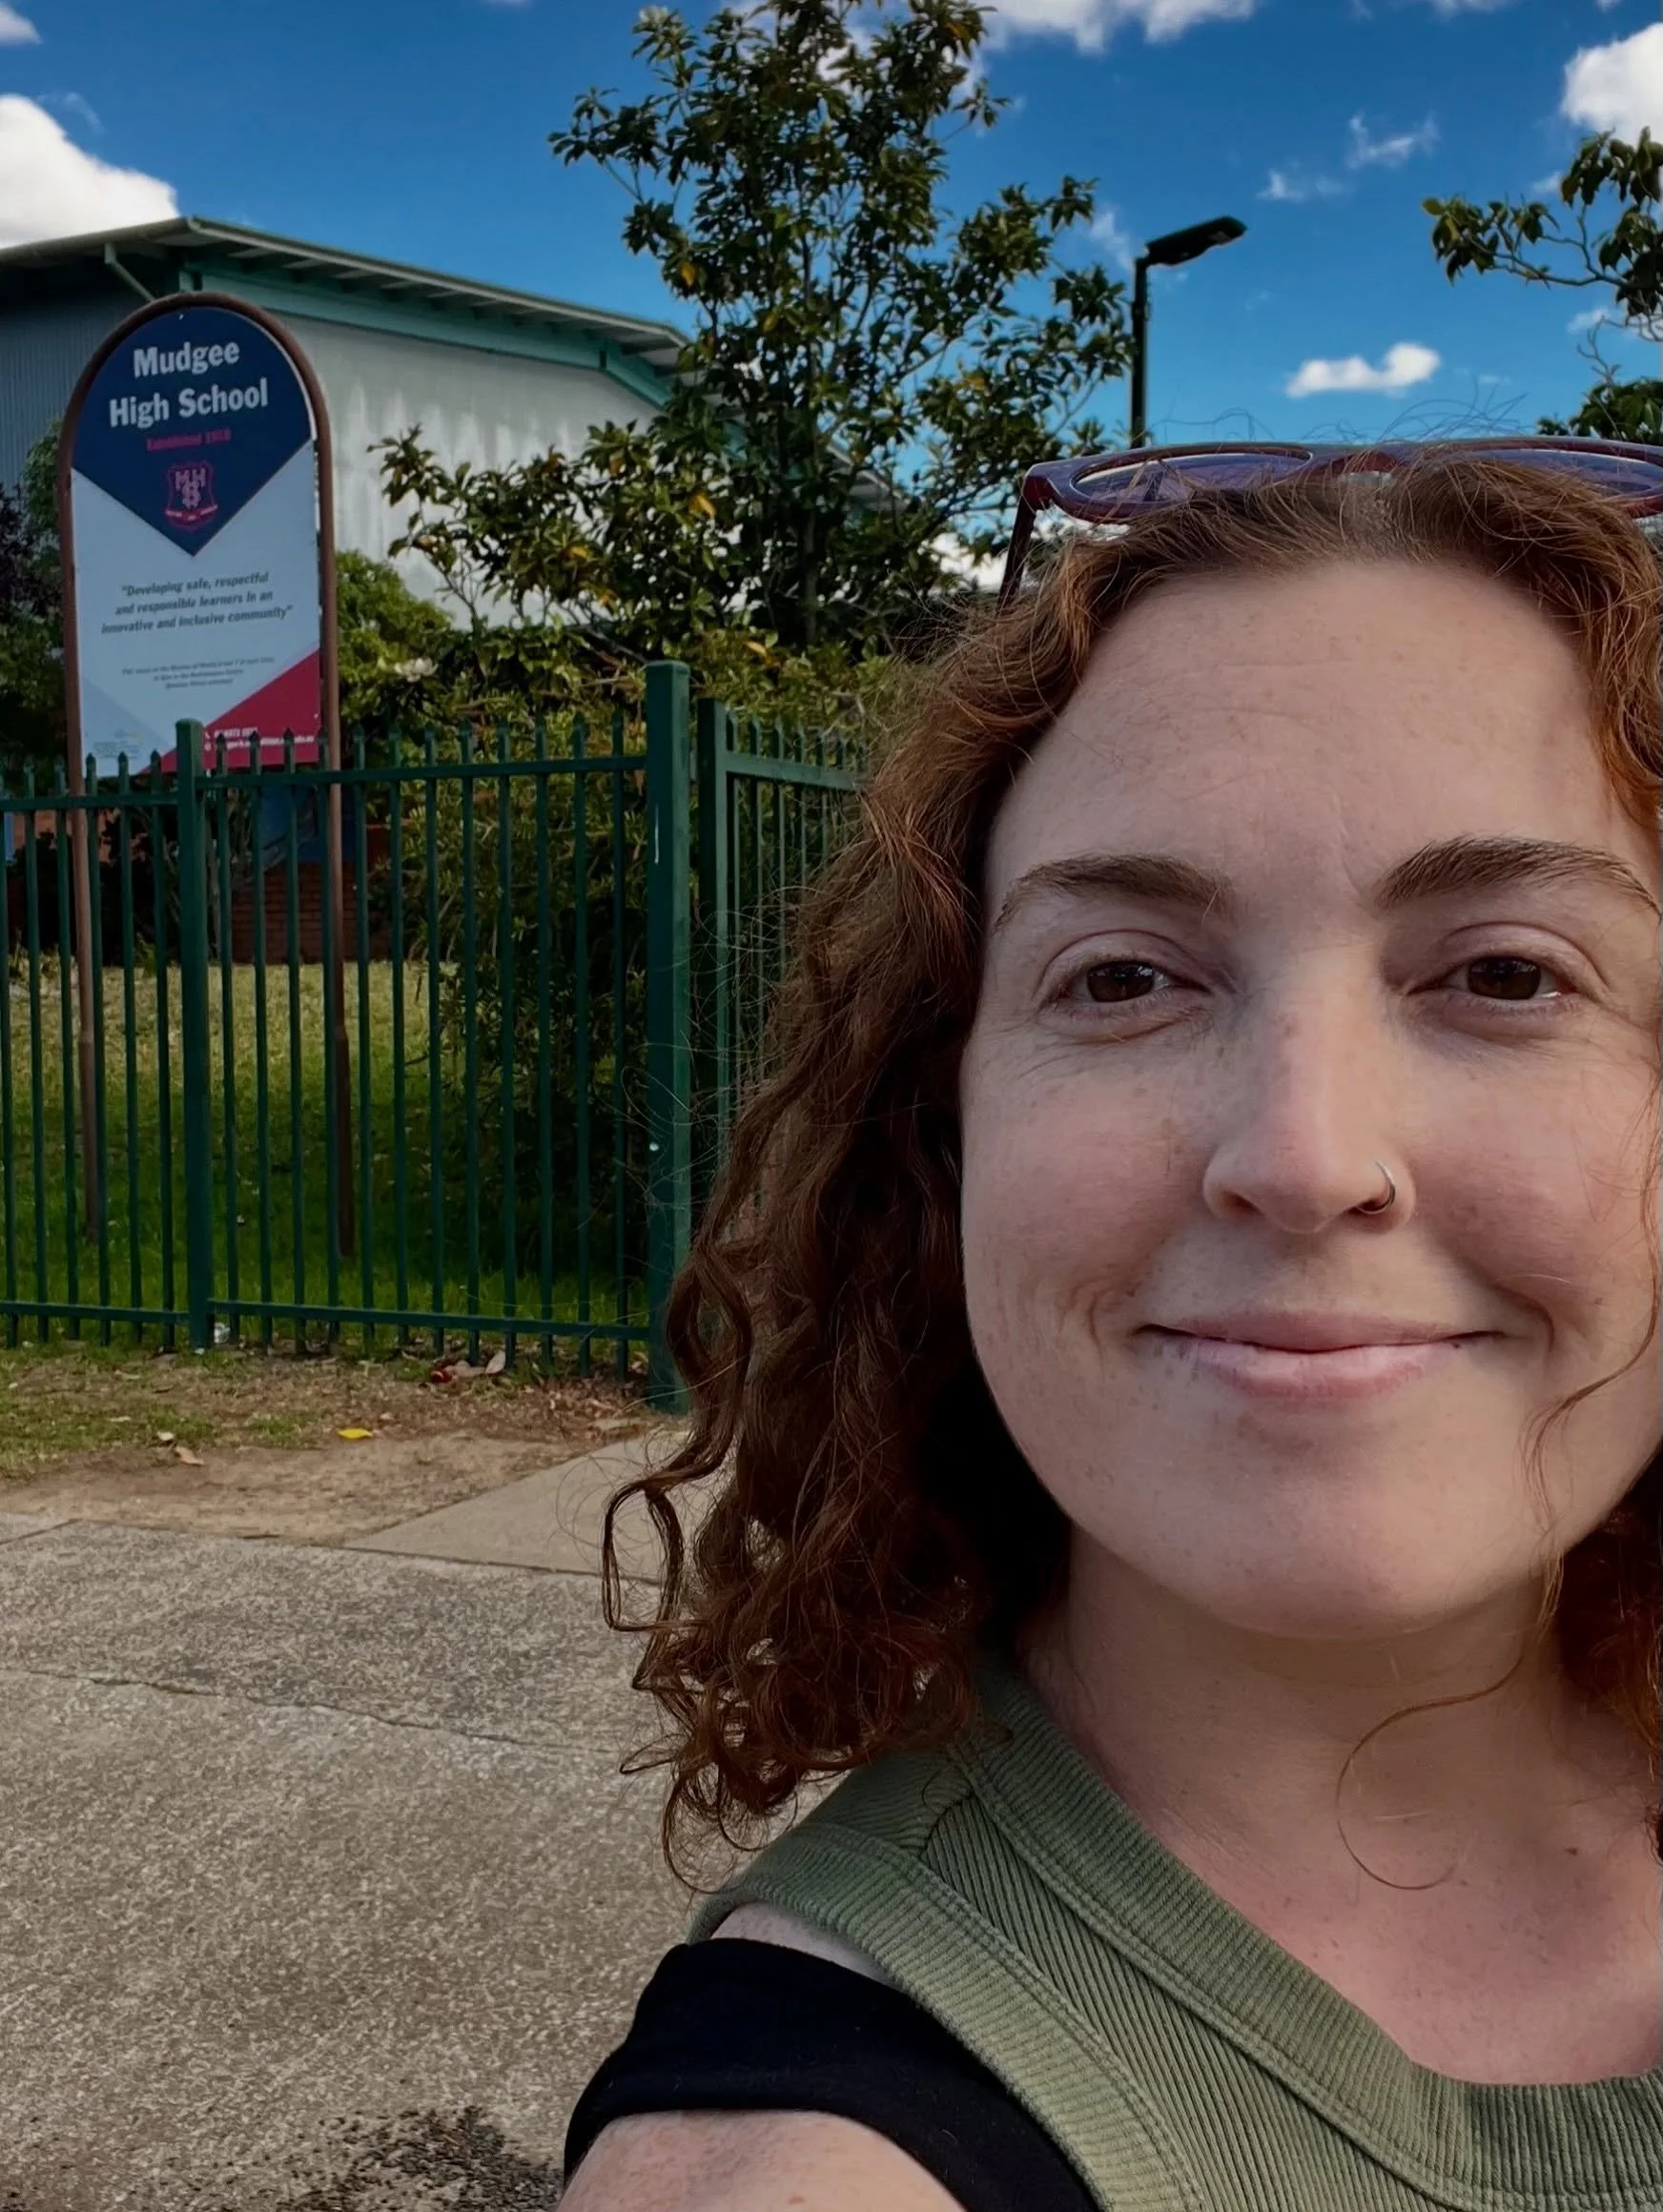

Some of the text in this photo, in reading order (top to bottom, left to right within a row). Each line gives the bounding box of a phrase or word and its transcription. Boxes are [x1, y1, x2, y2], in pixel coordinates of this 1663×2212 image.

[133, 341, 240, 379] Mudgee
[109, 377, 269, 428] High School
[186, 578, 212, 591] safe,
[215, 571, 270, 589] respectful
[114, 590, 274, 615] and responsible learners in an
[101, 619, 154, 635] innovative
[156, 616, 176, 629] and
[178, 612, 225, 627] inclusive
